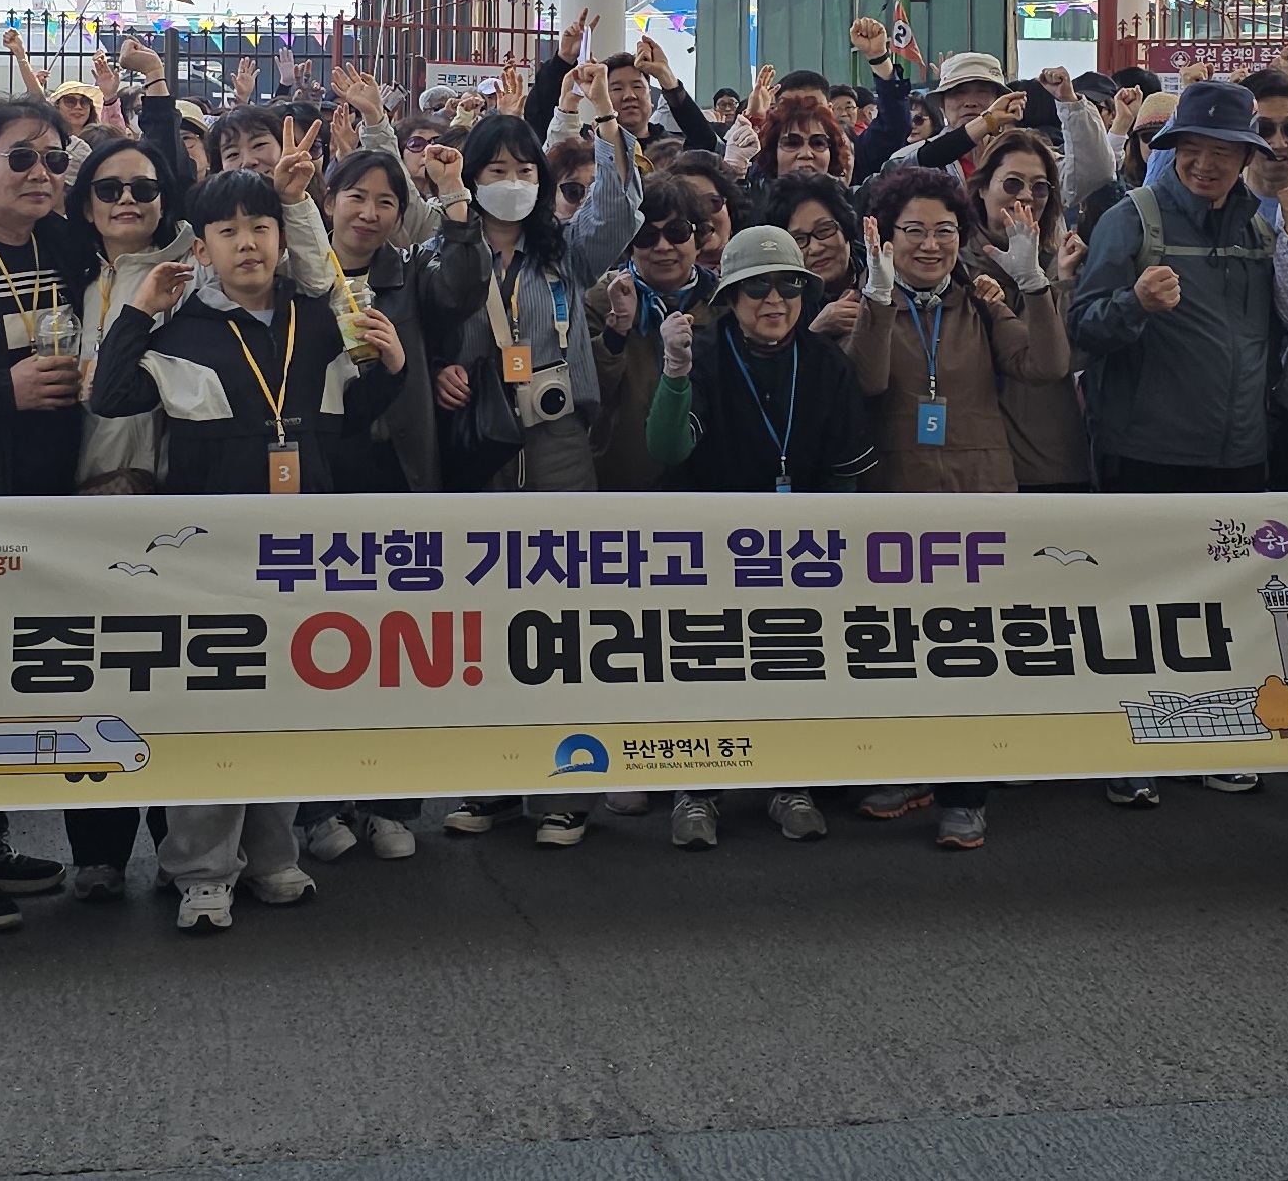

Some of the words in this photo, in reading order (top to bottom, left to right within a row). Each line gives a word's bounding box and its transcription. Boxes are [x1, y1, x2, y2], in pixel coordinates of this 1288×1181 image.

[894, 24, 907, 44] 2
[1195, 47, 1217, 62] 유선
[1221, 47, 1256, 62] 승객의
[437, 73, 478, 87] 크루즈내
[512, 357, 524, 371] 3
[926, 416, 938, 432] 5
[278, 465, 290, 482] 3
[256, 529, 444, 592] 부산행
[465, 529, 707, 589] 기차타고
[727, 528, 846, 588] 일상
[867, 531, 1006, 584] OFF
[1207, 543, 1250, 563] 행복도시
[11, 613, 267, 694] 중구로
[291, 610, 484, 690] ON!
[507, 607, 827, 685] 여러분을
[843, 602, 1233, 680] 환영합니다
[622, 738, 710, 760] 부산광역시
[716, 737, 753, 757] 중구
[659, 761, 683, 769] BUSAN
[684, 760, 737, 768] METROPOLITAN
[738, 759, 754, 767] CITY
